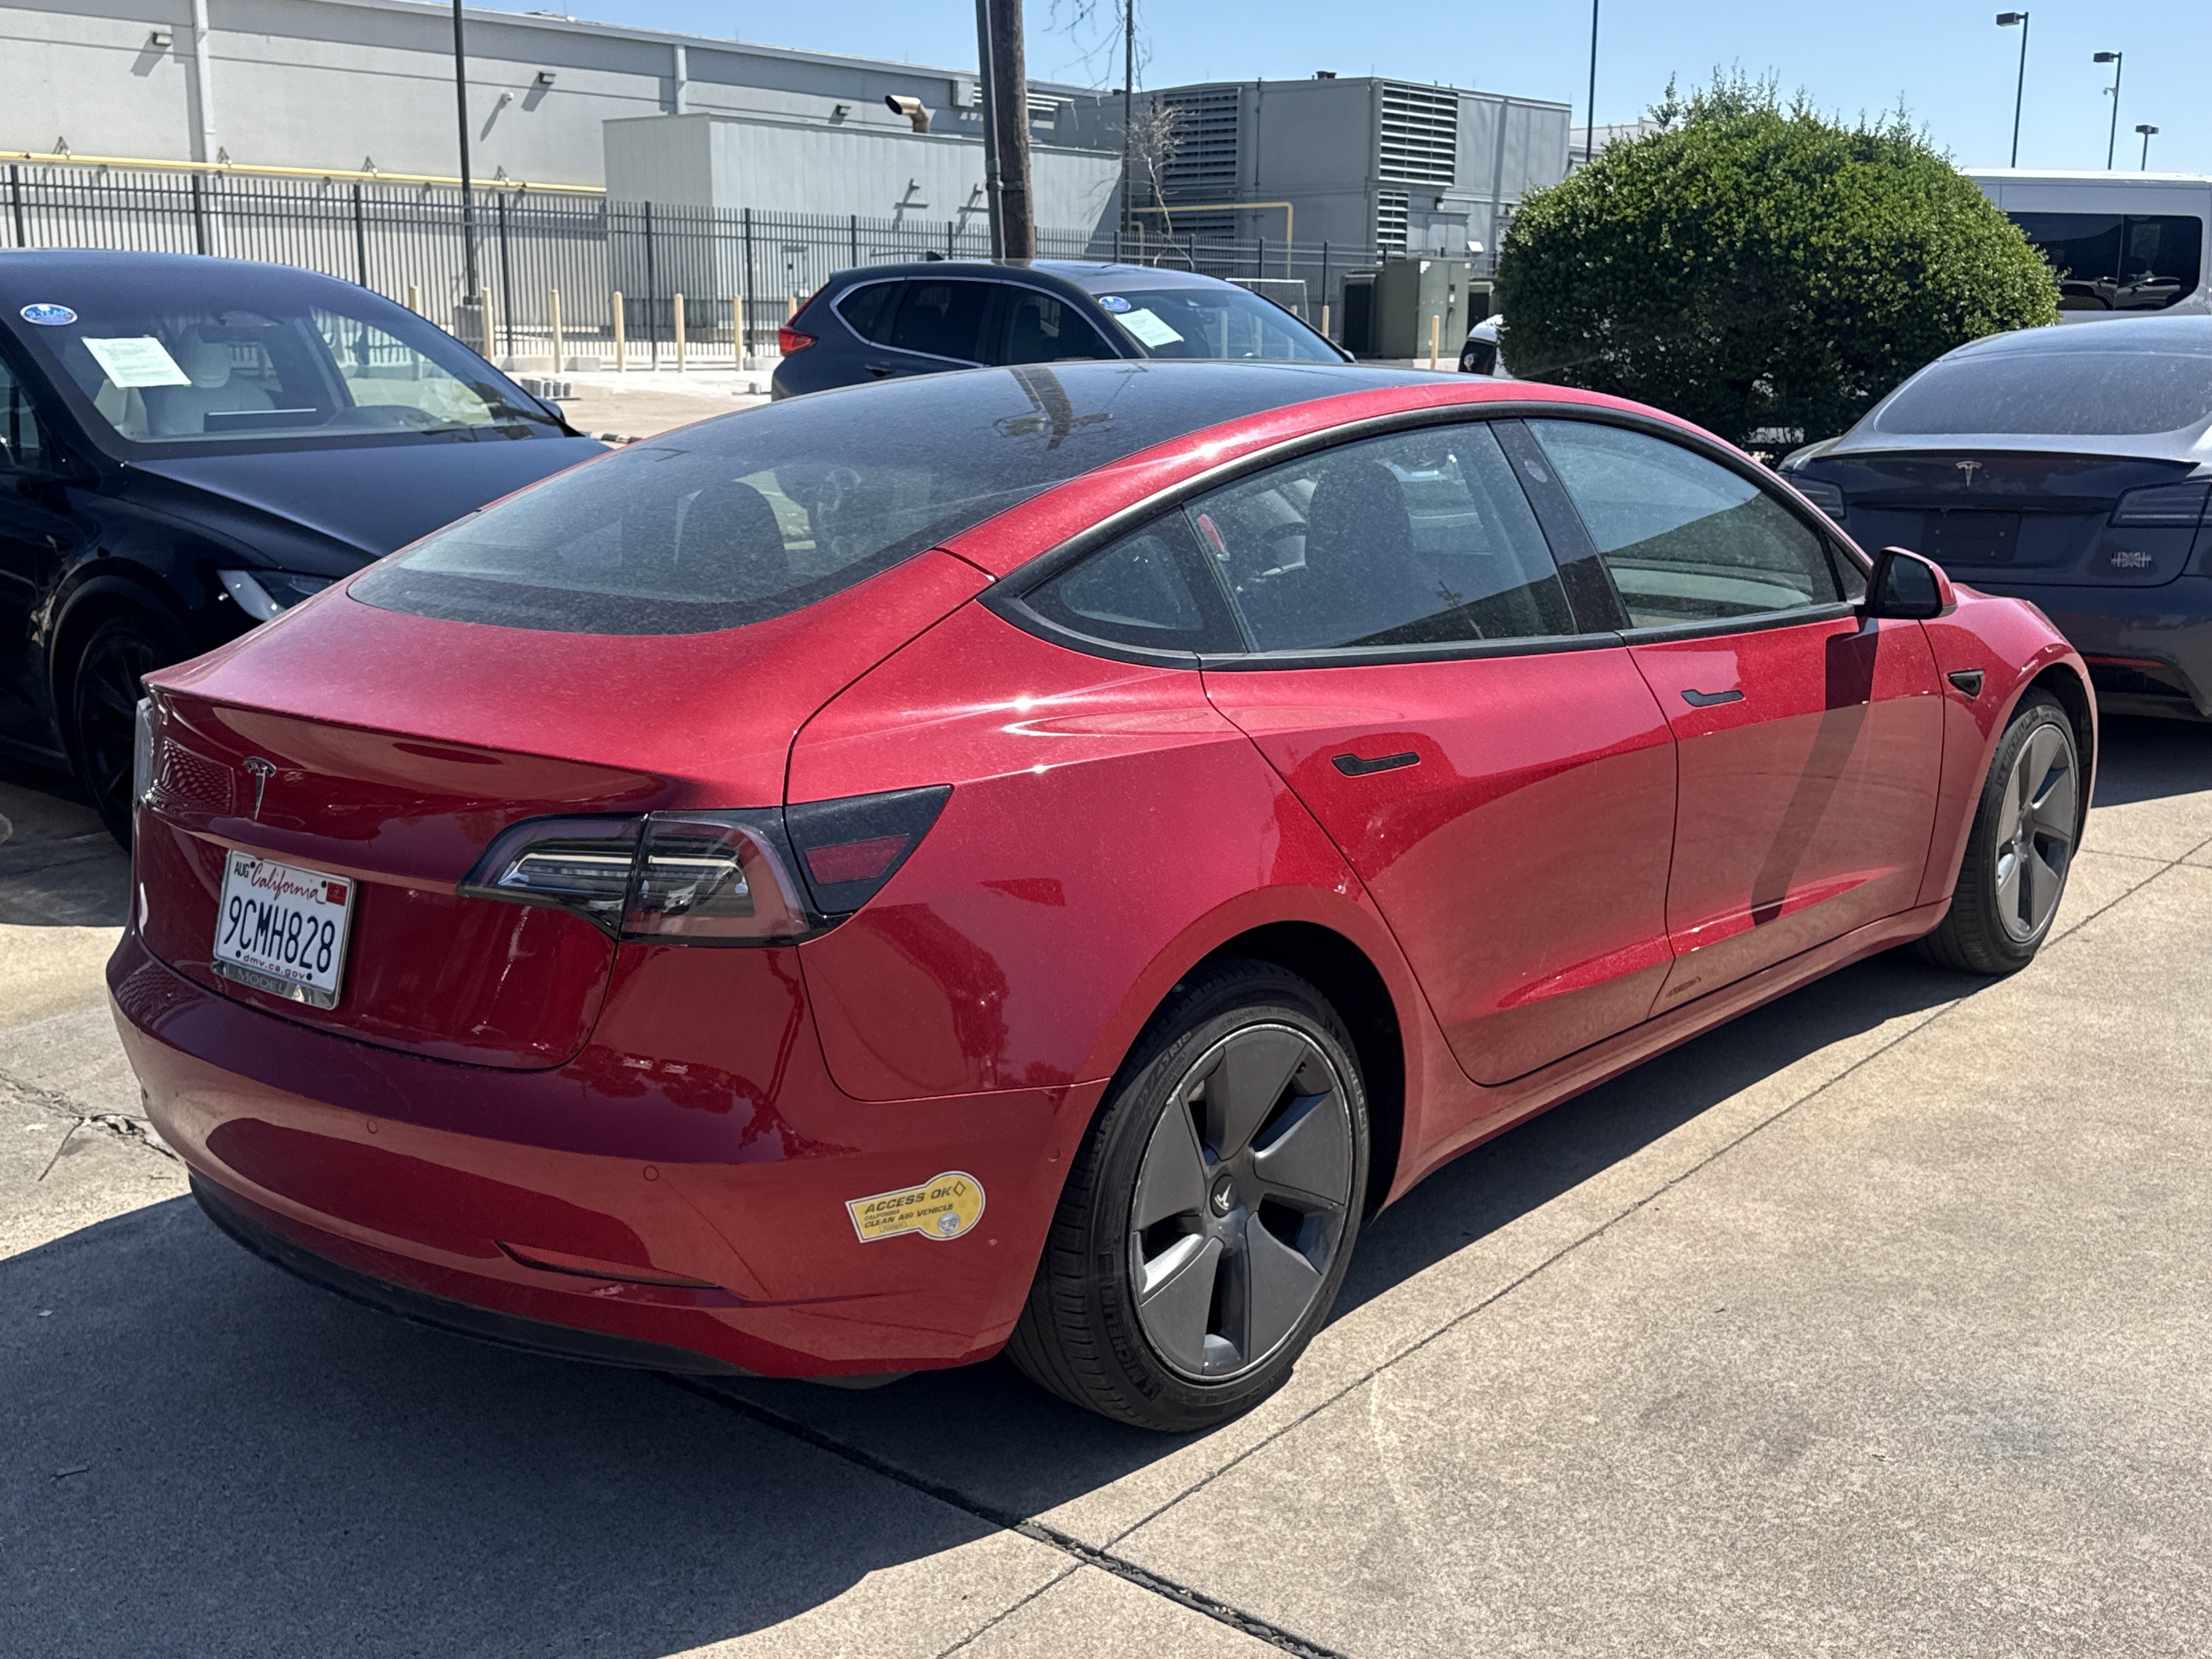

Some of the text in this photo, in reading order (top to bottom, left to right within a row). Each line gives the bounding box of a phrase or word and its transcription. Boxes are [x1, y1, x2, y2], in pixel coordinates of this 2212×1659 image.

[234, 861, 250, 878] AUG
[251, 862, 326, 905] California
[223, 896, 336, 974] 9CMH828
[237, 968, 284, 992] MODEL
[243, 955, 306, 980] dmv.ca.gov
[864, 1186, 952, 1214] ACCESS OK
[864, 1216, 895, 1228] CLEAN
[898, 1212, 914, 1221] AIR
[917, 1204, 953, 1217] VEHICLE
